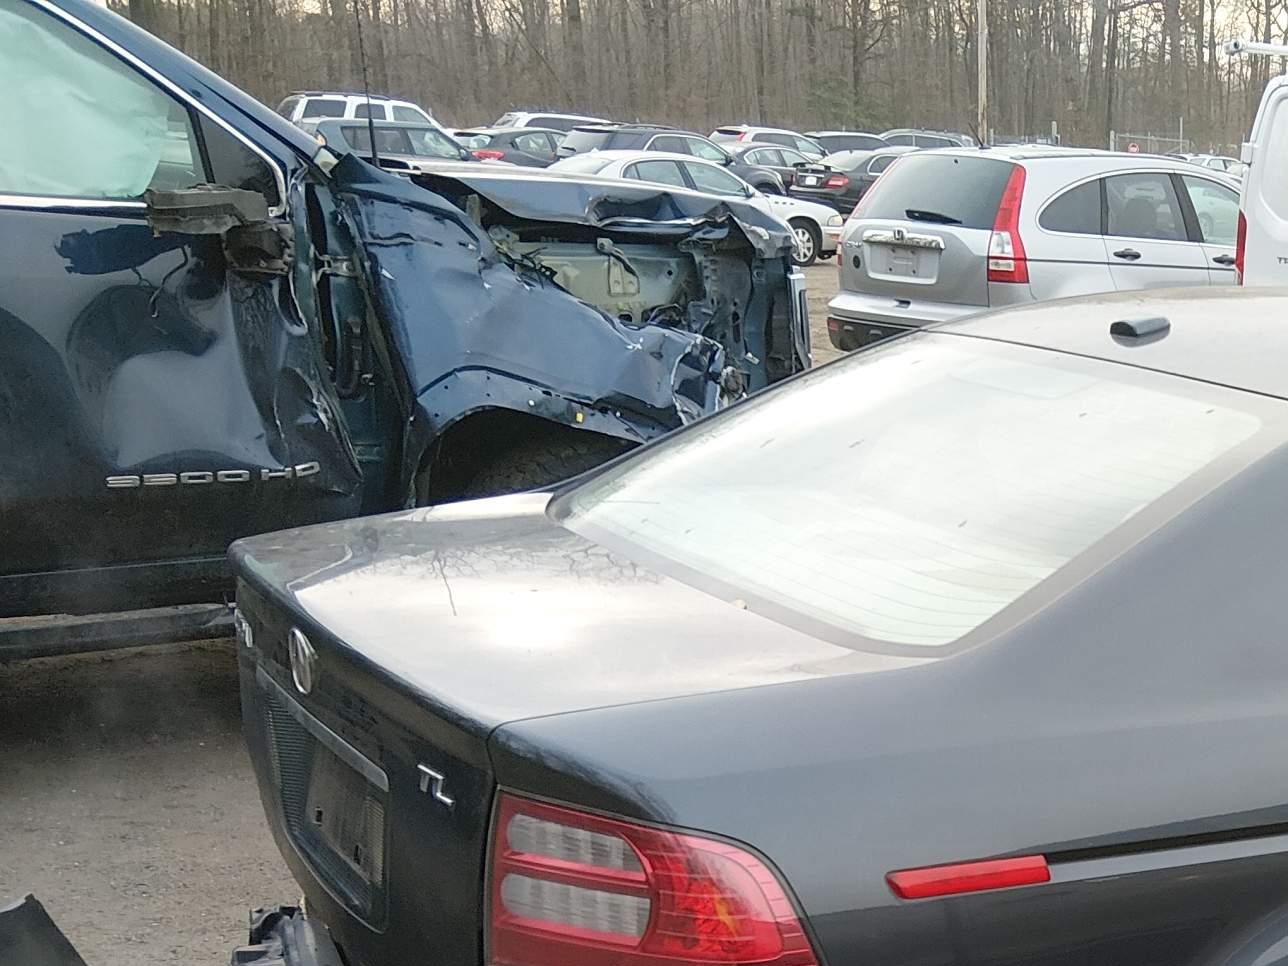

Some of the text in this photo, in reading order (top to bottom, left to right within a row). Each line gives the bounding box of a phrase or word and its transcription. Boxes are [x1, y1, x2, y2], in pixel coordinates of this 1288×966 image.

[106, 461, 321, 488] 3500 HD
[417, 764, 454, 807] TL
